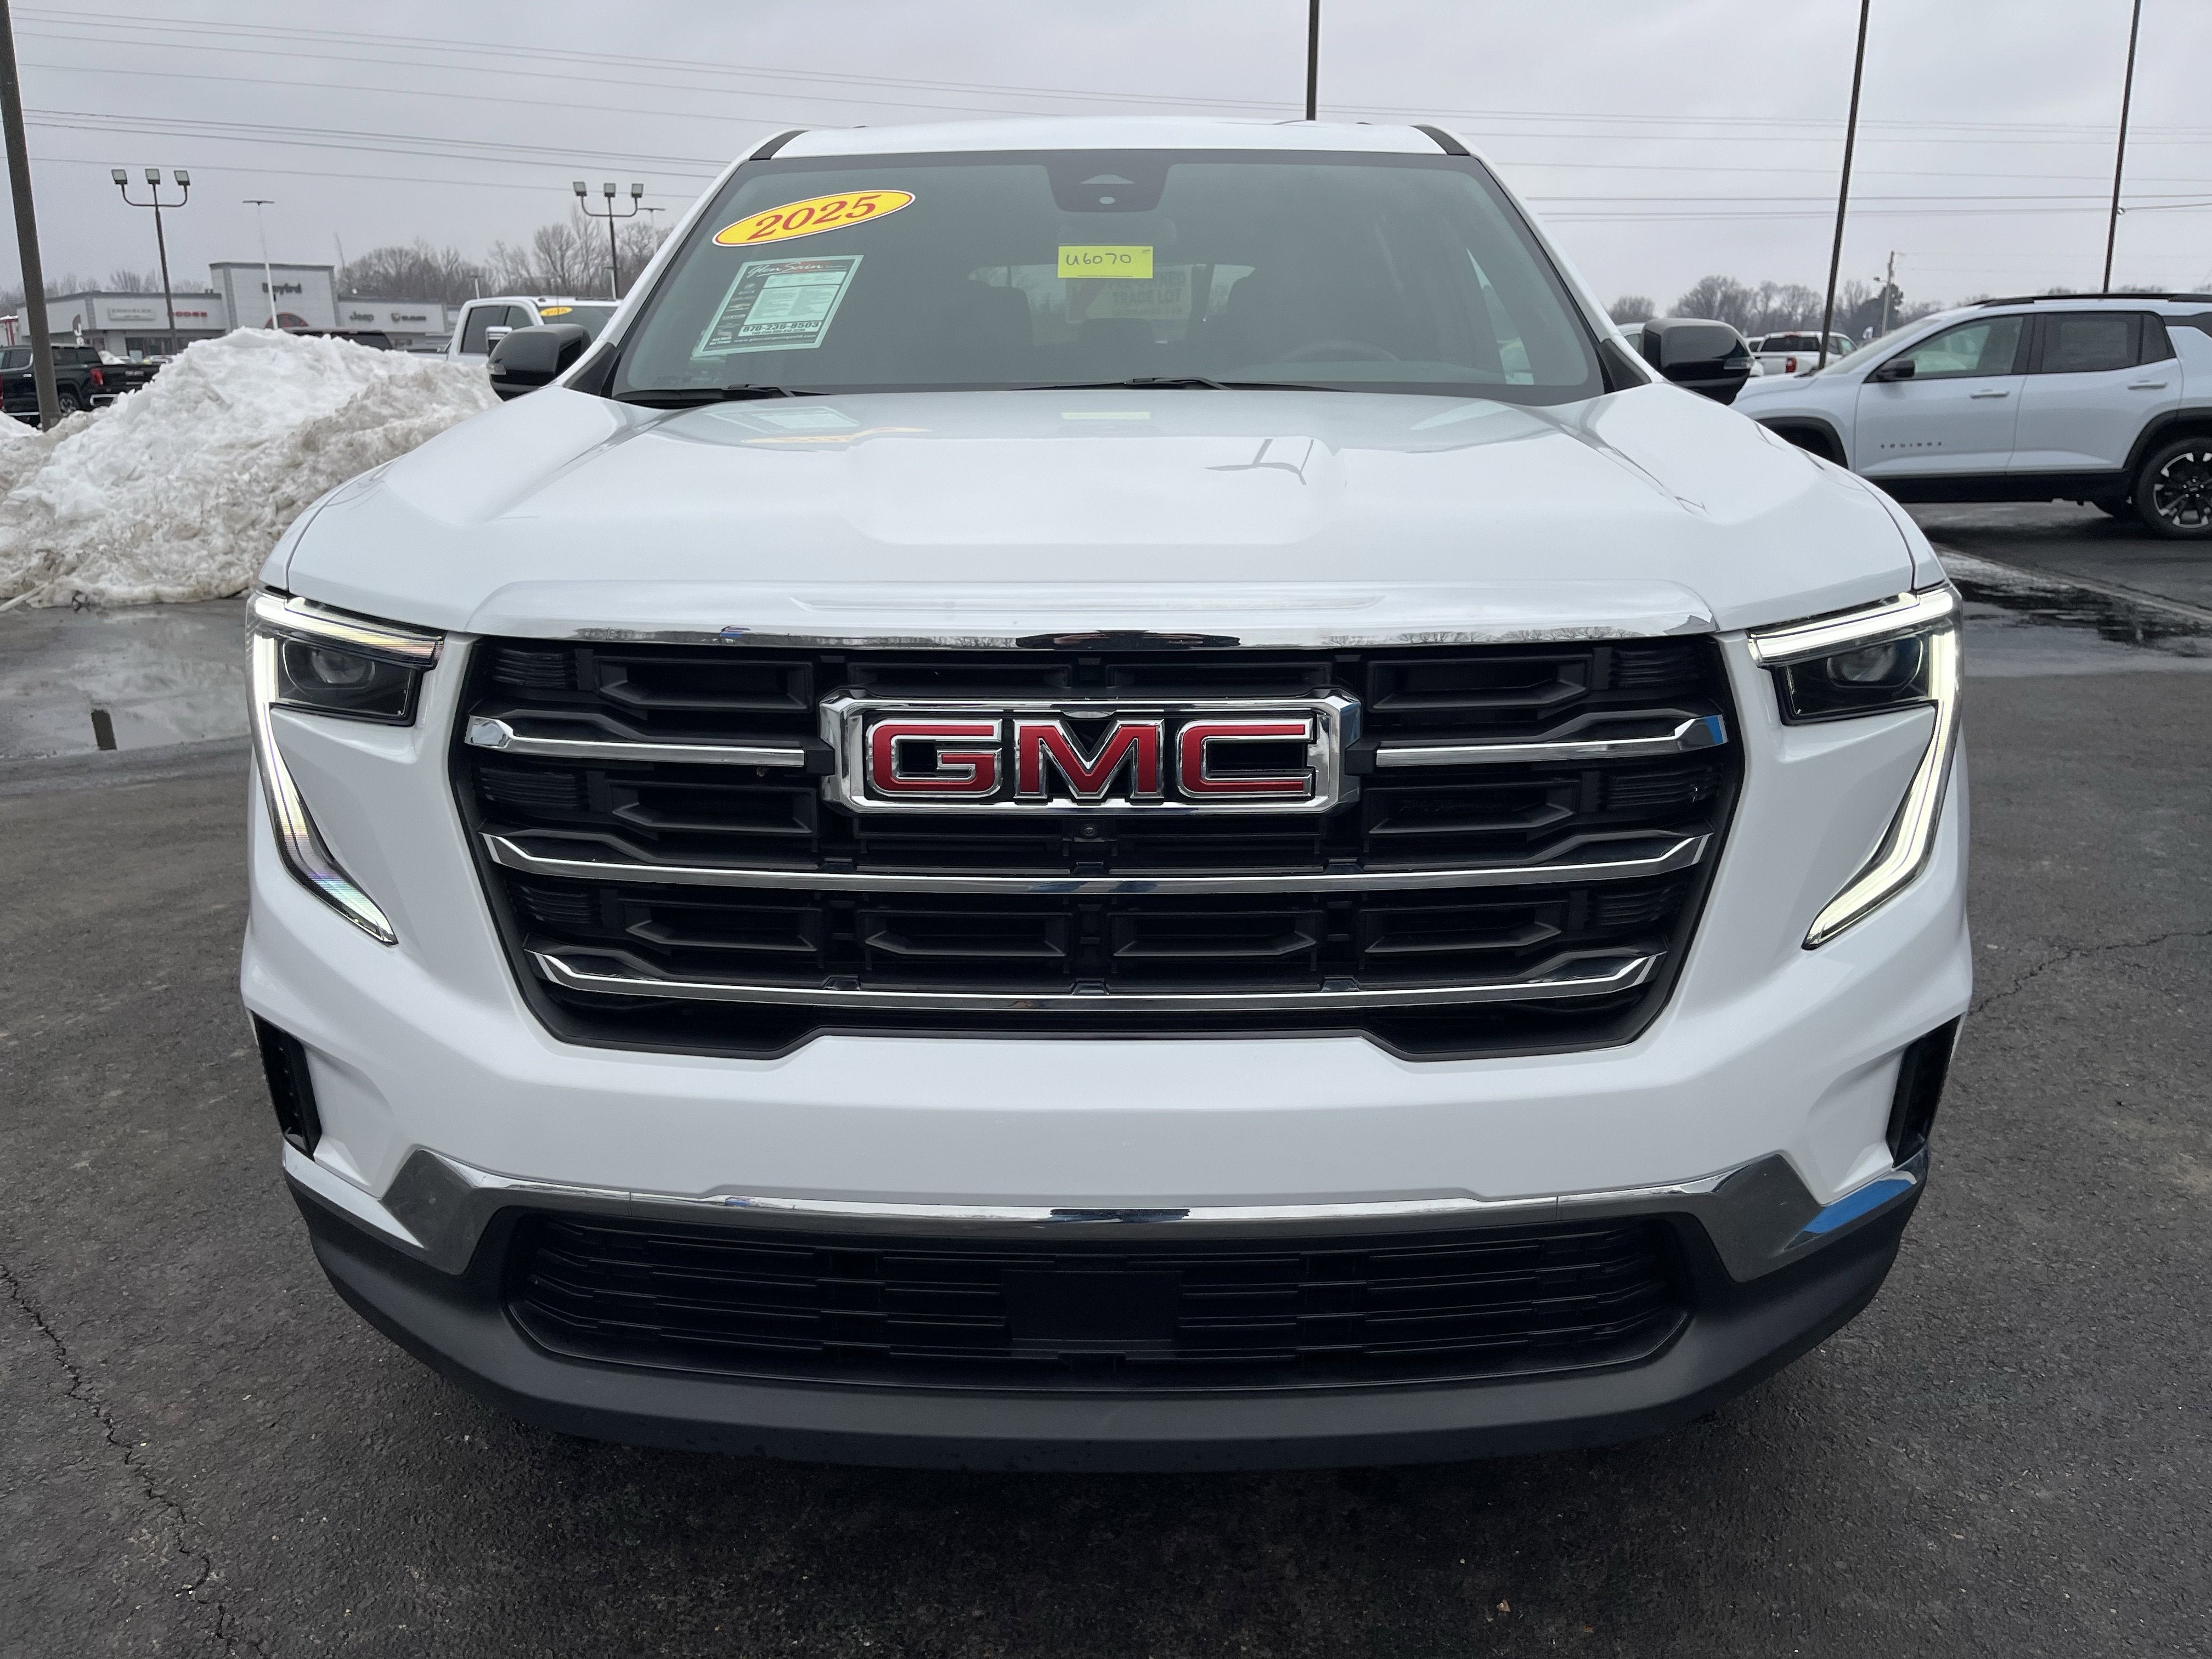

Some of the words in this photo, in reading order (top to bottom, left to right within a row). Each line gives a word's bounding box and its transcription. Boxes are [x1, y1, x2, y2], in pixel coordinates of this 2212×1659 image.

[747, 194, 882, 241] 2025
[747, 264, 783, 278] Glen
[783, 262, 824, 273] Sain
[349, 311, 374, 323] Jeep
[743, 321, 820, 332] 870-236-8503
[866, 718, 1316, 799] GMC
